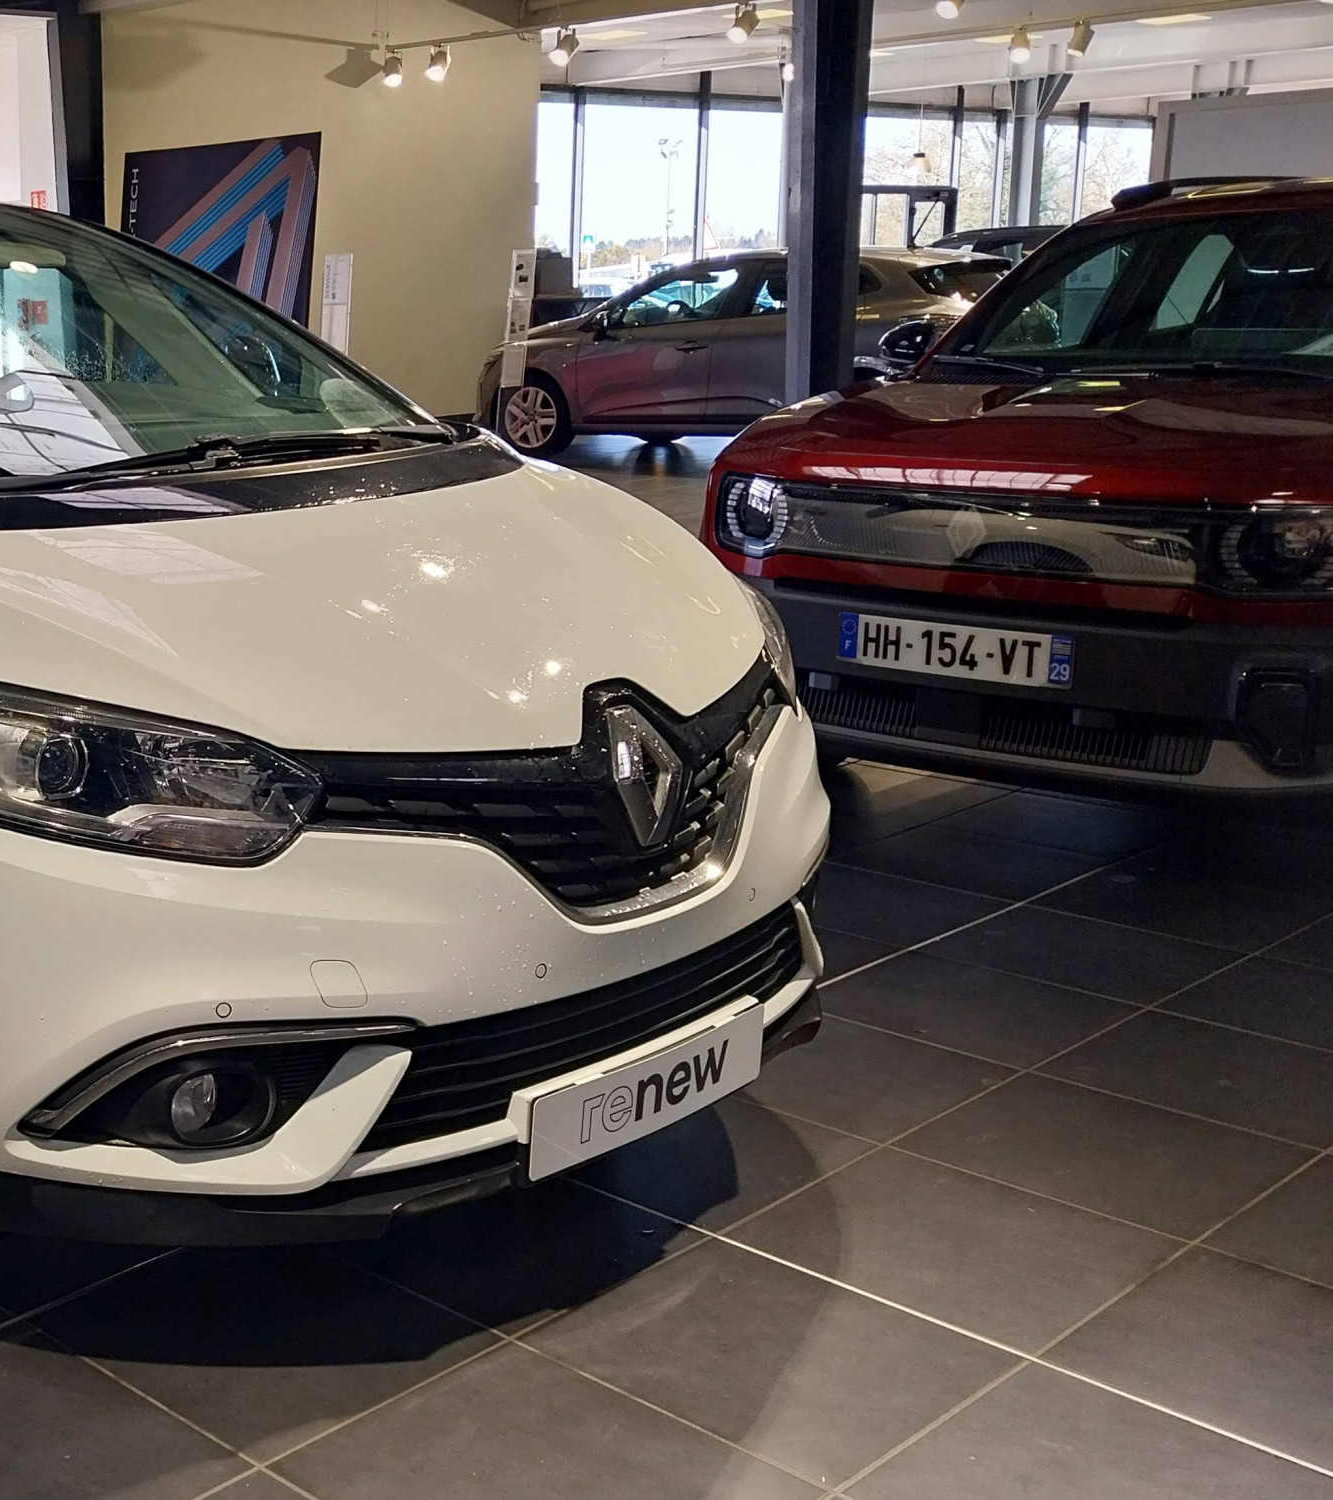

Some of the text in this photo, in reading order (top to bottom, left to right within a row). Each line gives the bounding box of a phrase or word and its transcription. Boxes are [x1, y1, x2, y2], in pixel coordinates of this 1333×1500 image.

[129, 168, 139, 237] -TECH
[844, 640, 852, 650] F
[862, 621, 1042, 678] HH-154-VT
[1049, 662, 1070, 681] 29
[580, 1038, 730, 1144] renew
